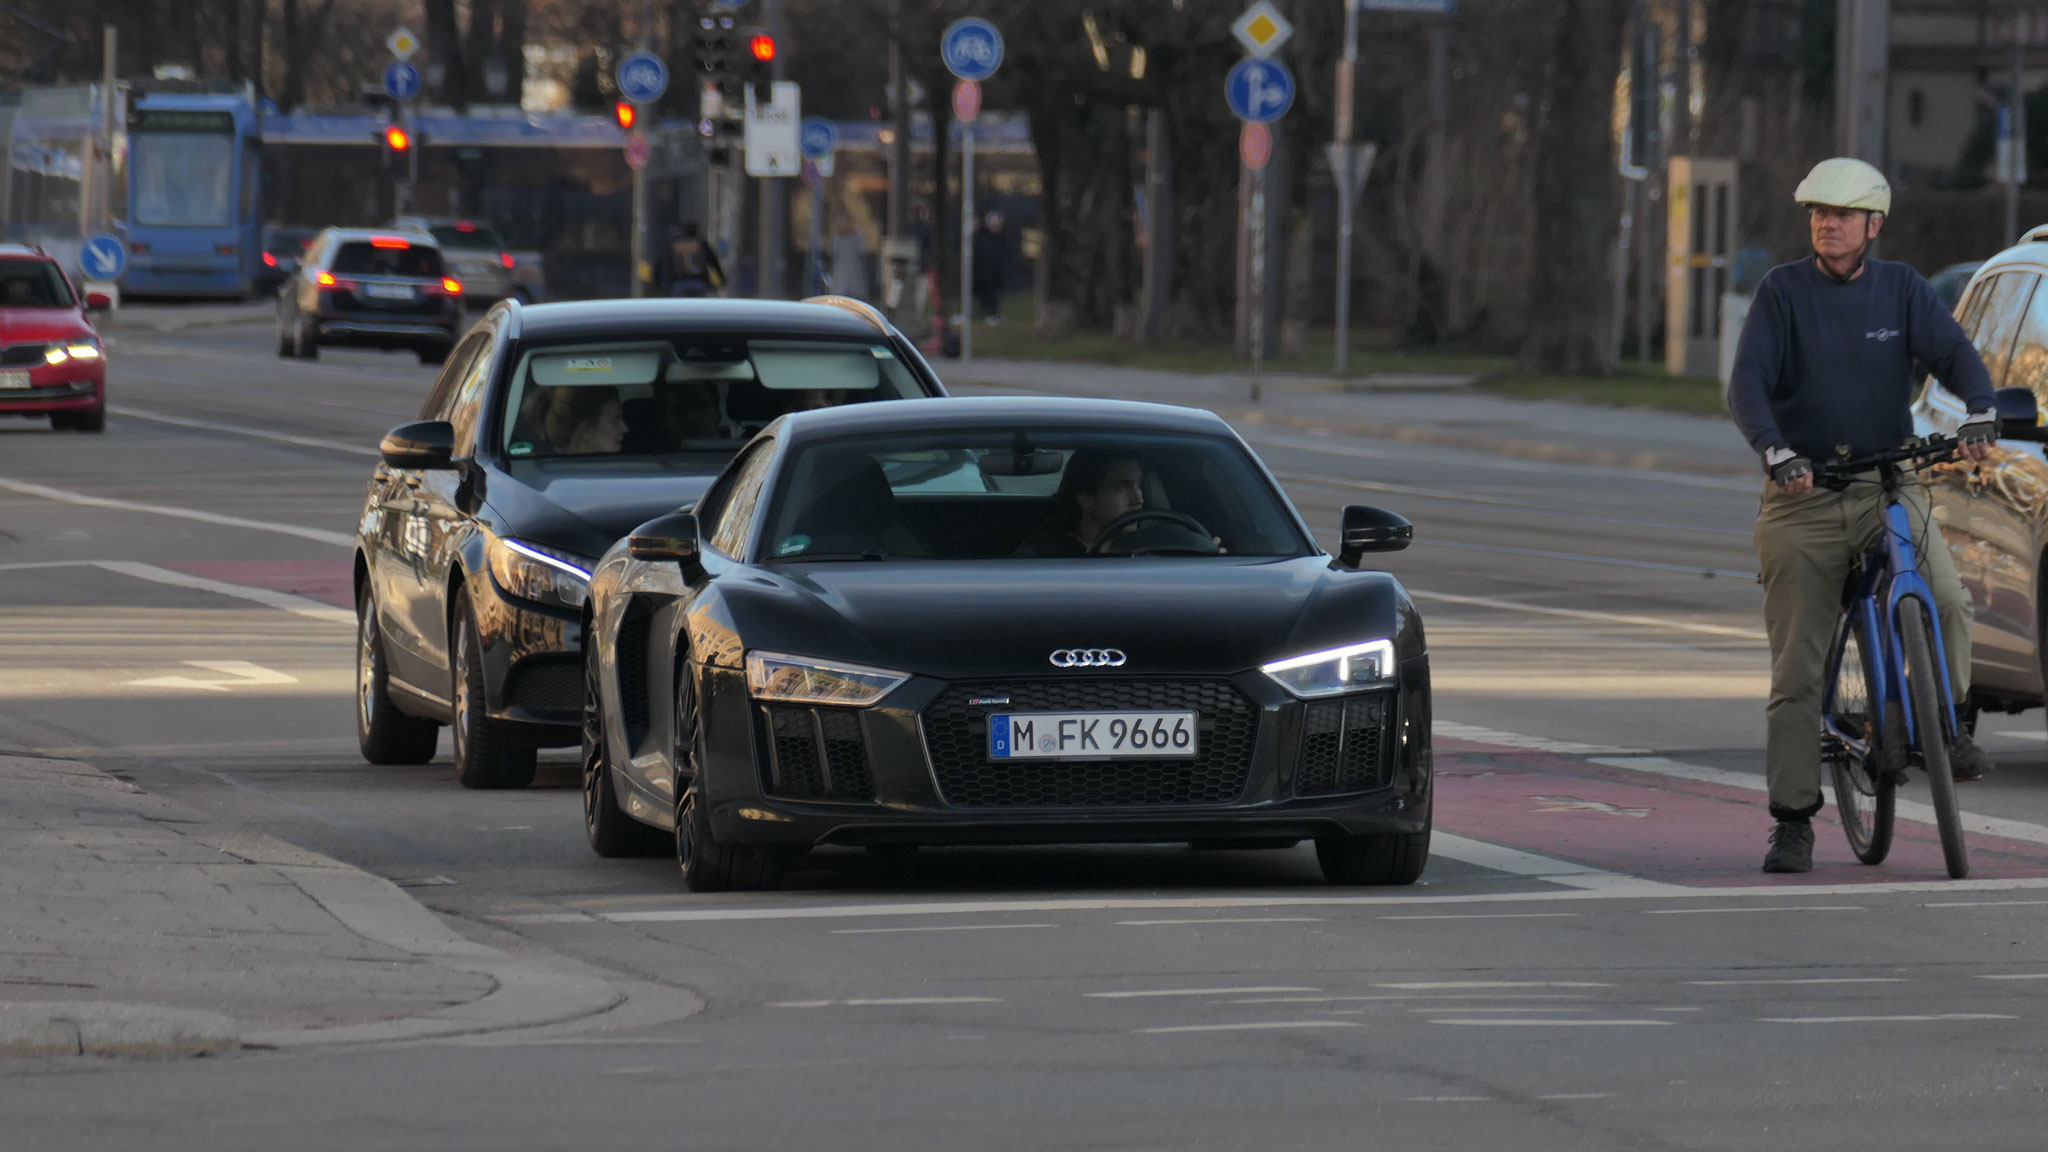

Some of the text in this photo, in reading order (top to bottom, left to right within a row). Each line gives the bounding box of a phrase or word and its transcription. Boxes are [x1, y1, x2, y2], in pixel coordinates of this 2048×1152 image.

[997, 740, 1005, 750] D
[1013, 718, 1190, 751] M FK 9666
